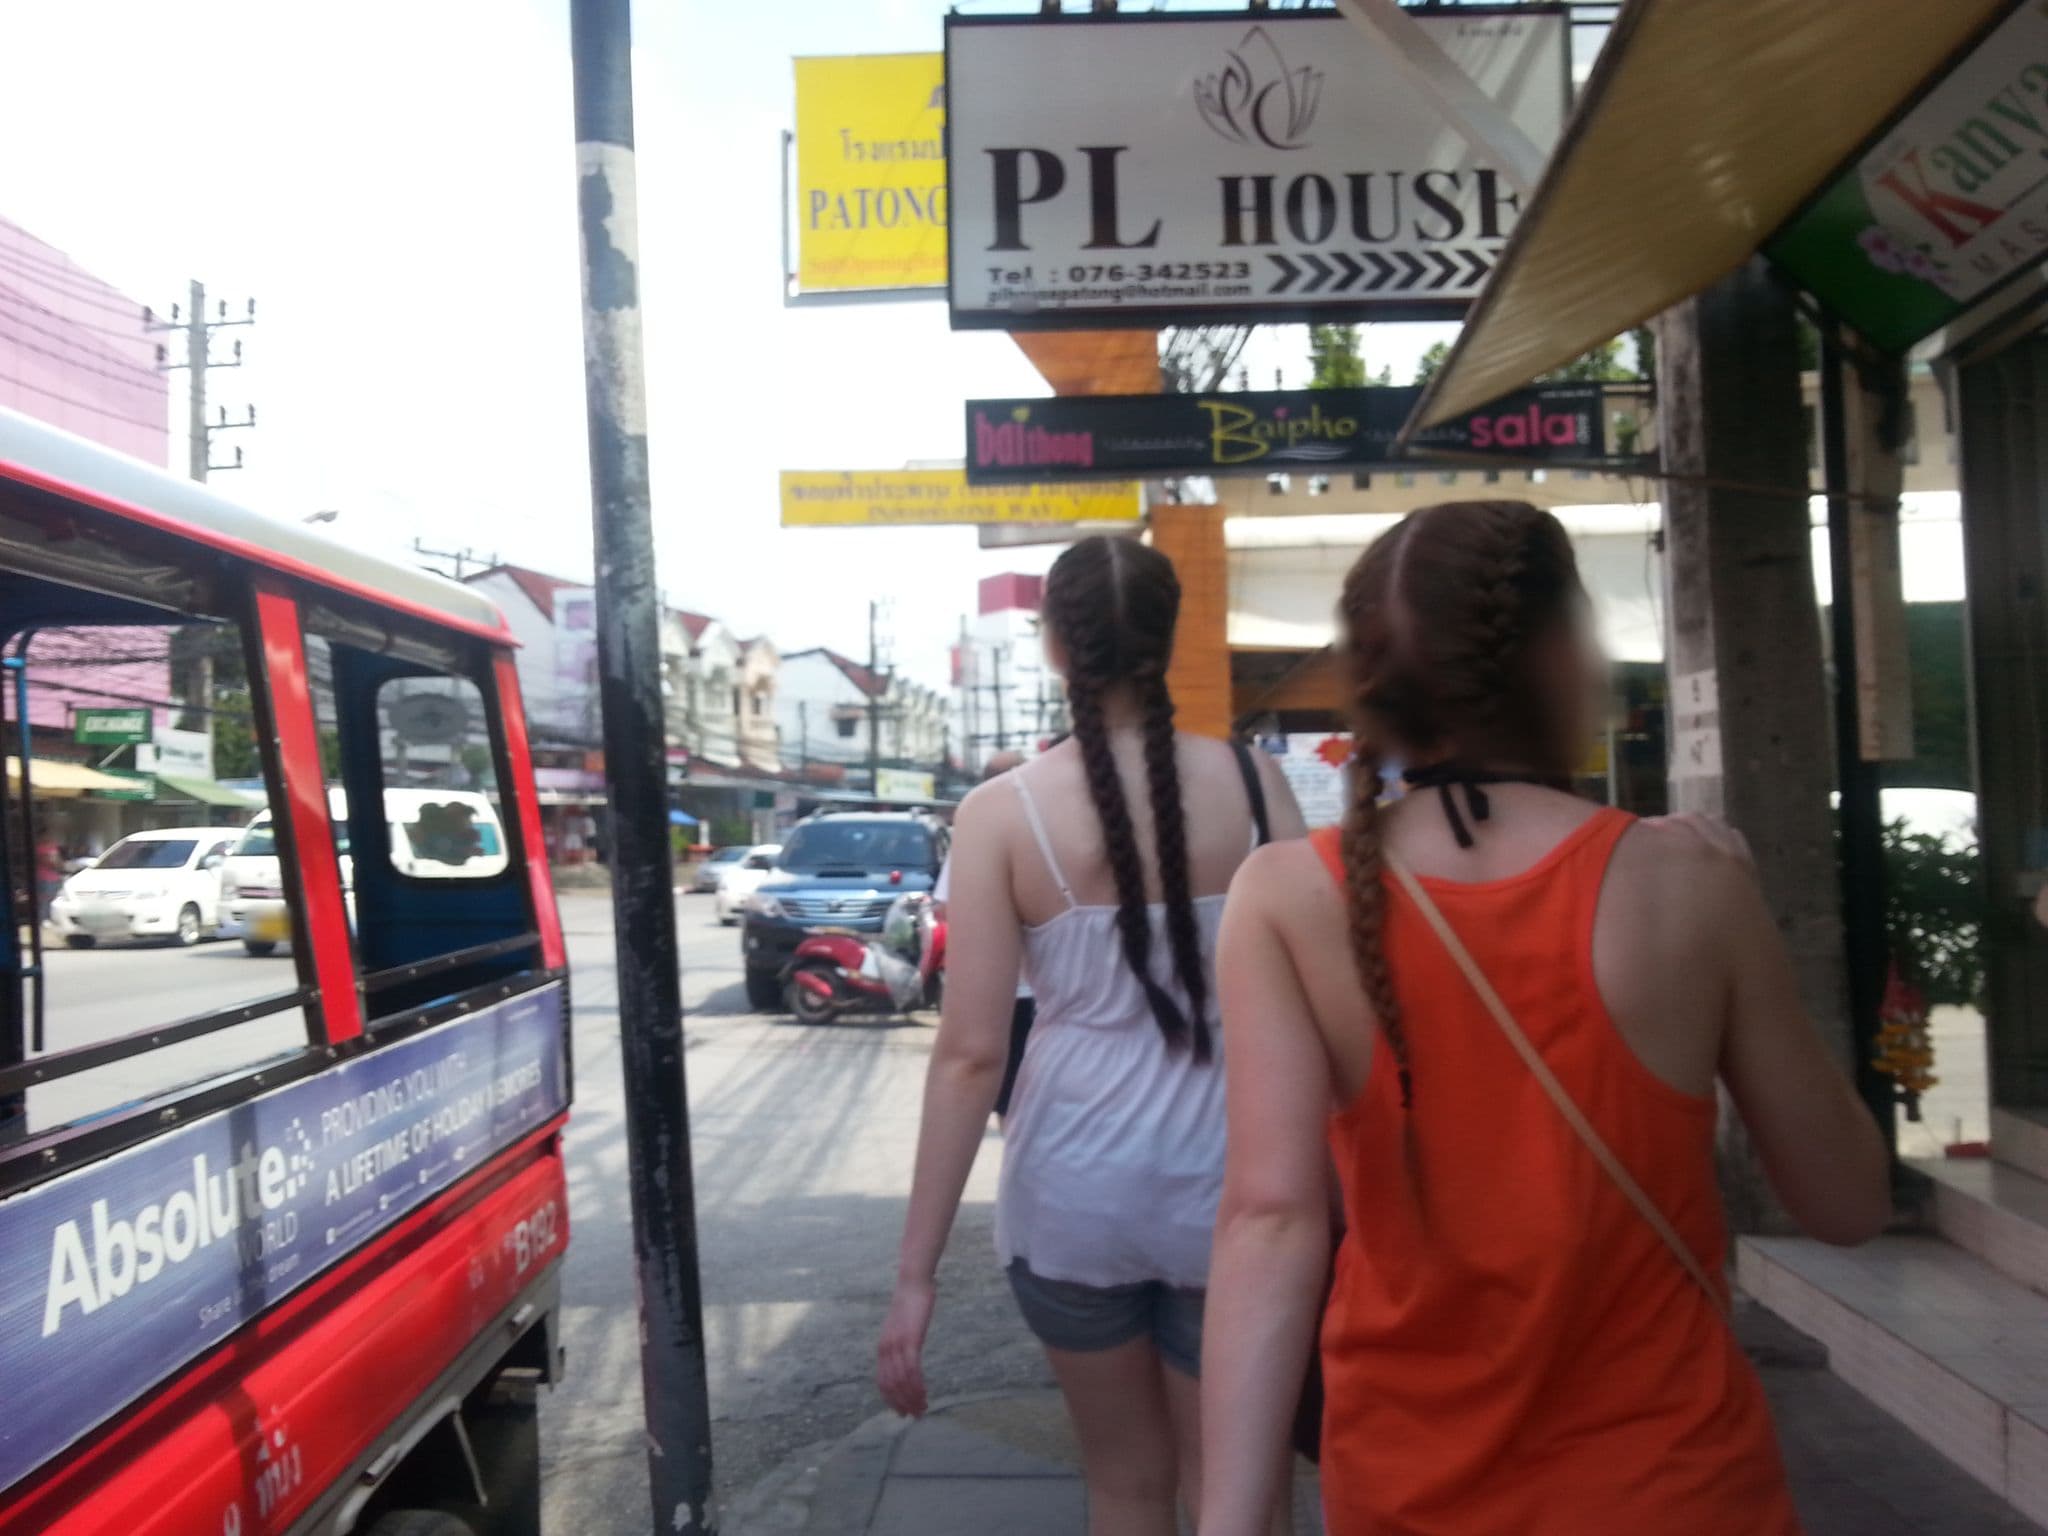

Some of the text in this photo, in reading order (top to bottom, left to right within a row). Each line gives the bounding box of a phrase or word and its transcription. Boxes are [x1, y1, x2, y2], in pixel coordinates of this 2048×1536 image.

[984, 145, 1163, 252] PL
[988, 266, 1032, 284] Tel
[1068, 262, 1250, 283] 076-342523
[1197, 401, 1357, 463] Baipho
[1470, 404, 1576, 447] sala
[343, 1128, 410, 1195] LIFETIME
[410, 1117, 434, 1155] OF
[41, 1140, 287, 1338] Absolute
